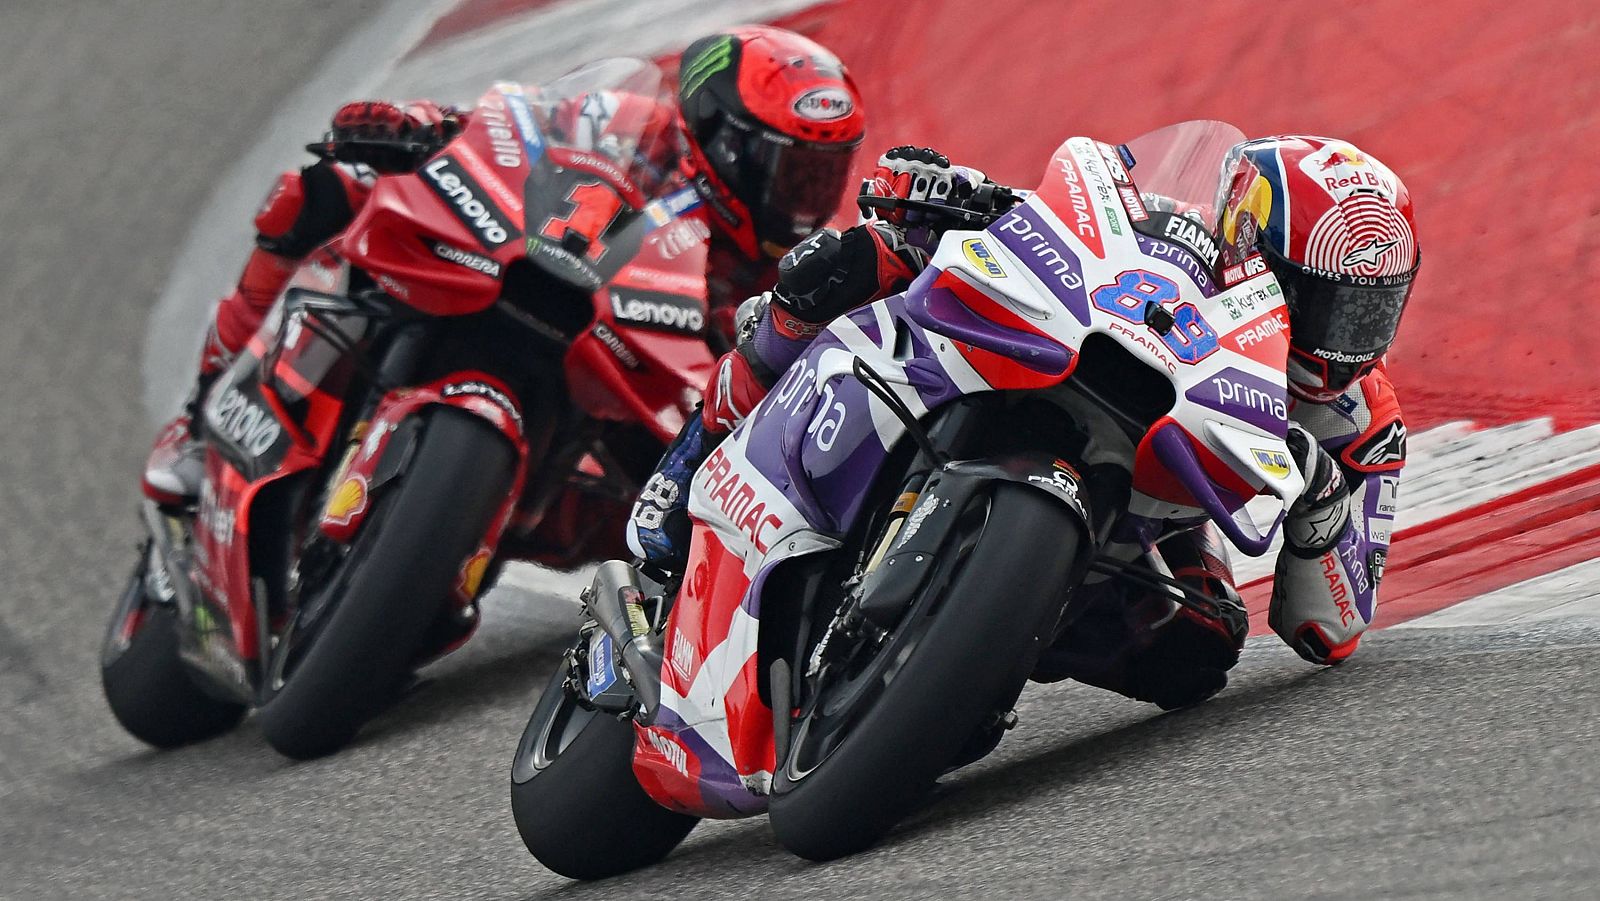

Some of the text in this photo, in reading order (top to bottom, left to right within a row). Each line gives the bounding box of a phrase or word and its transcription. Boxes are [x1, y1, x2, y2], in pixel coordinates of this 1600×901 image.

[425, 157, 508, 244] Lenovo
[1056, 156, 1096, 238] PRAMAC
[1119, 187, 1146, 220] MOTUL
[1324, 171, 1394, 195] Red Bll
[539, 182, 625, 264] 1
[1165, 215, 1220, 264] FIAMM
[435, 244, 501, 278] CARRERA
[998, 213, 1084, 290] prima
[1149, 242, 1208, 287] prima
[1350, 275, 1377, 286] YOU
[1383, 273, 1413, 286] WINGS
[611, 293, 704, 332] Lenovo
[1089, 268, 1221, 366] 89
[1235, 313, 1289, 351] PRAMAC
[1108, 322, 1177, 375] PRAMAC
[1312, 348, 1375, 364] MOTOBLOUZ
[1212, 377, 1288, 421] prima
[1256, 450, 1287, 468] WD-40
[703, 447, 784, 555] PRAMAC
[647, 729, 688, 778] MOTUL
